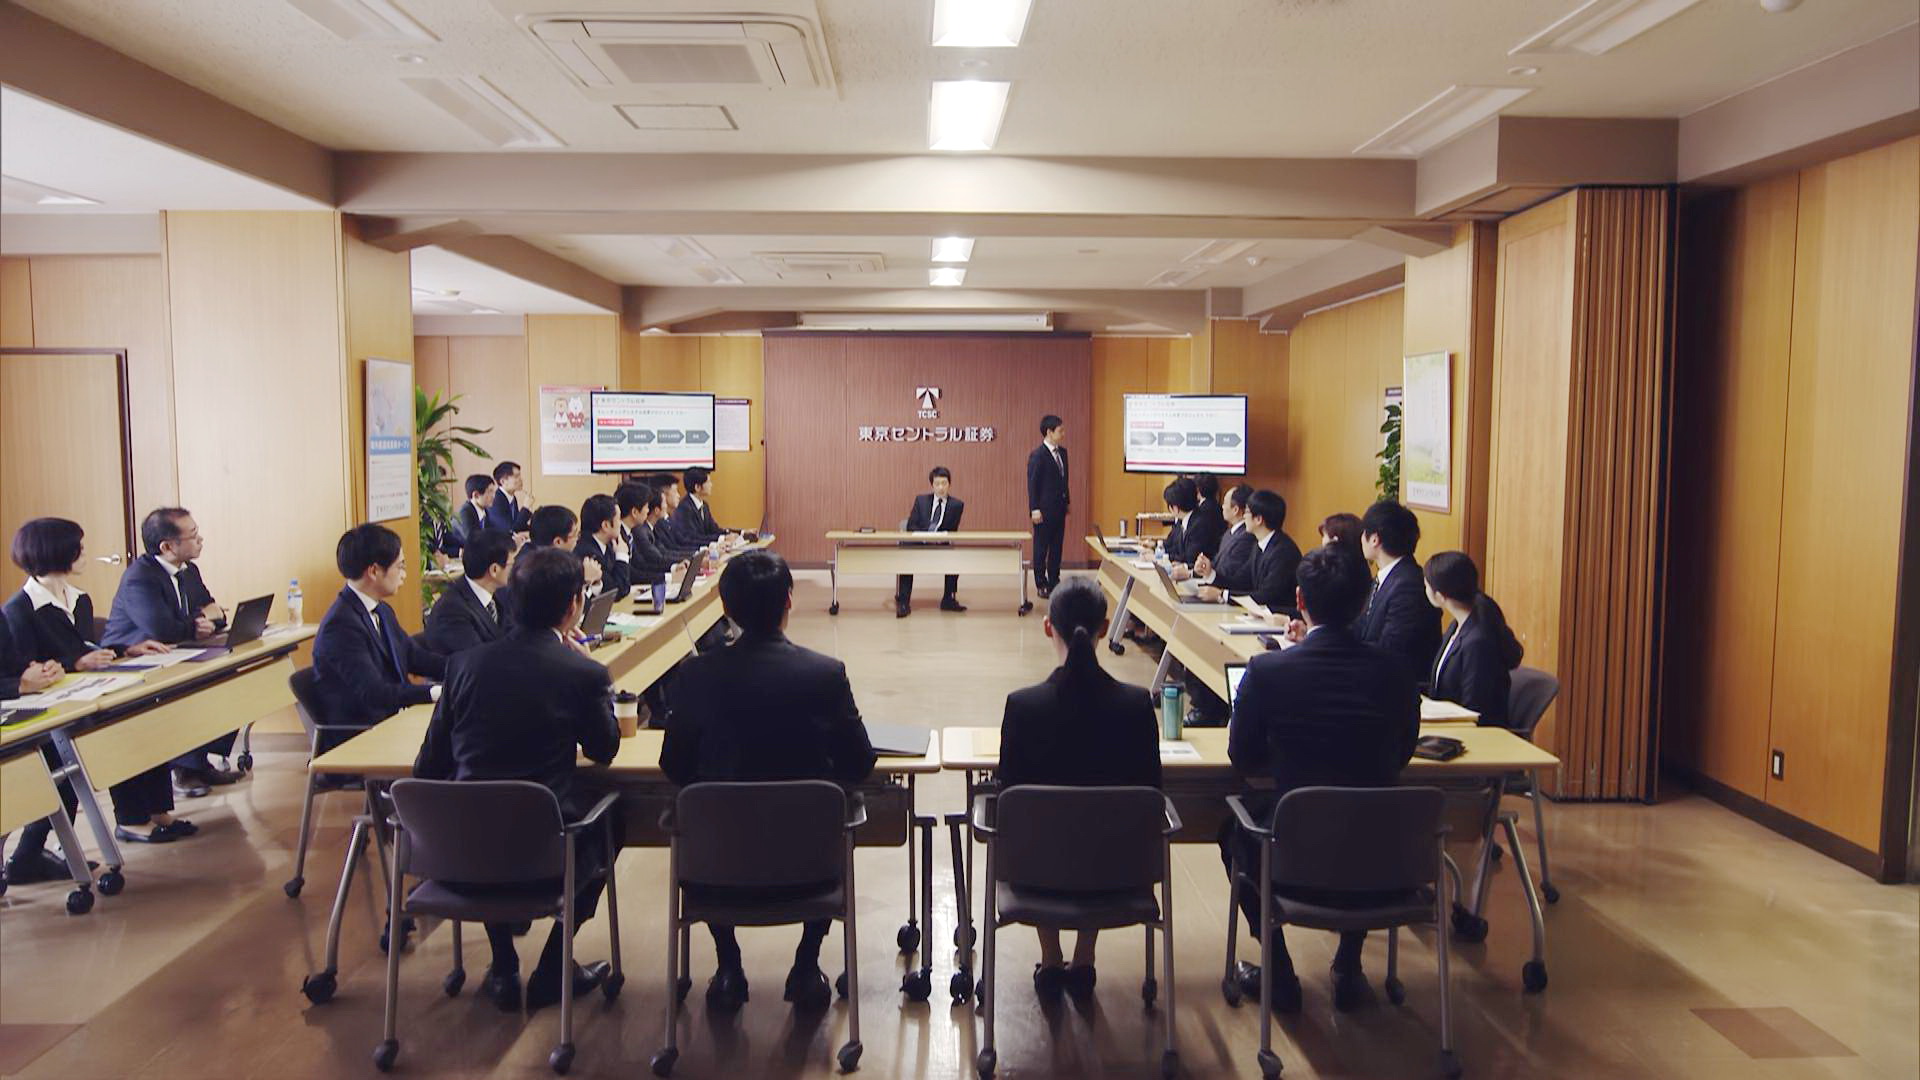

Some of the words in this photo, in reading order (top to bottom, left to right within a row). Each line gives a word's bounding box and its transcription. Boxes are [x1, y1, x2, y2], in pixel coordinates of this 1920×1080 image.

[917, 410, 937, 419] TCSC
[858, 426, 994, 442] 東京セントラル証券
